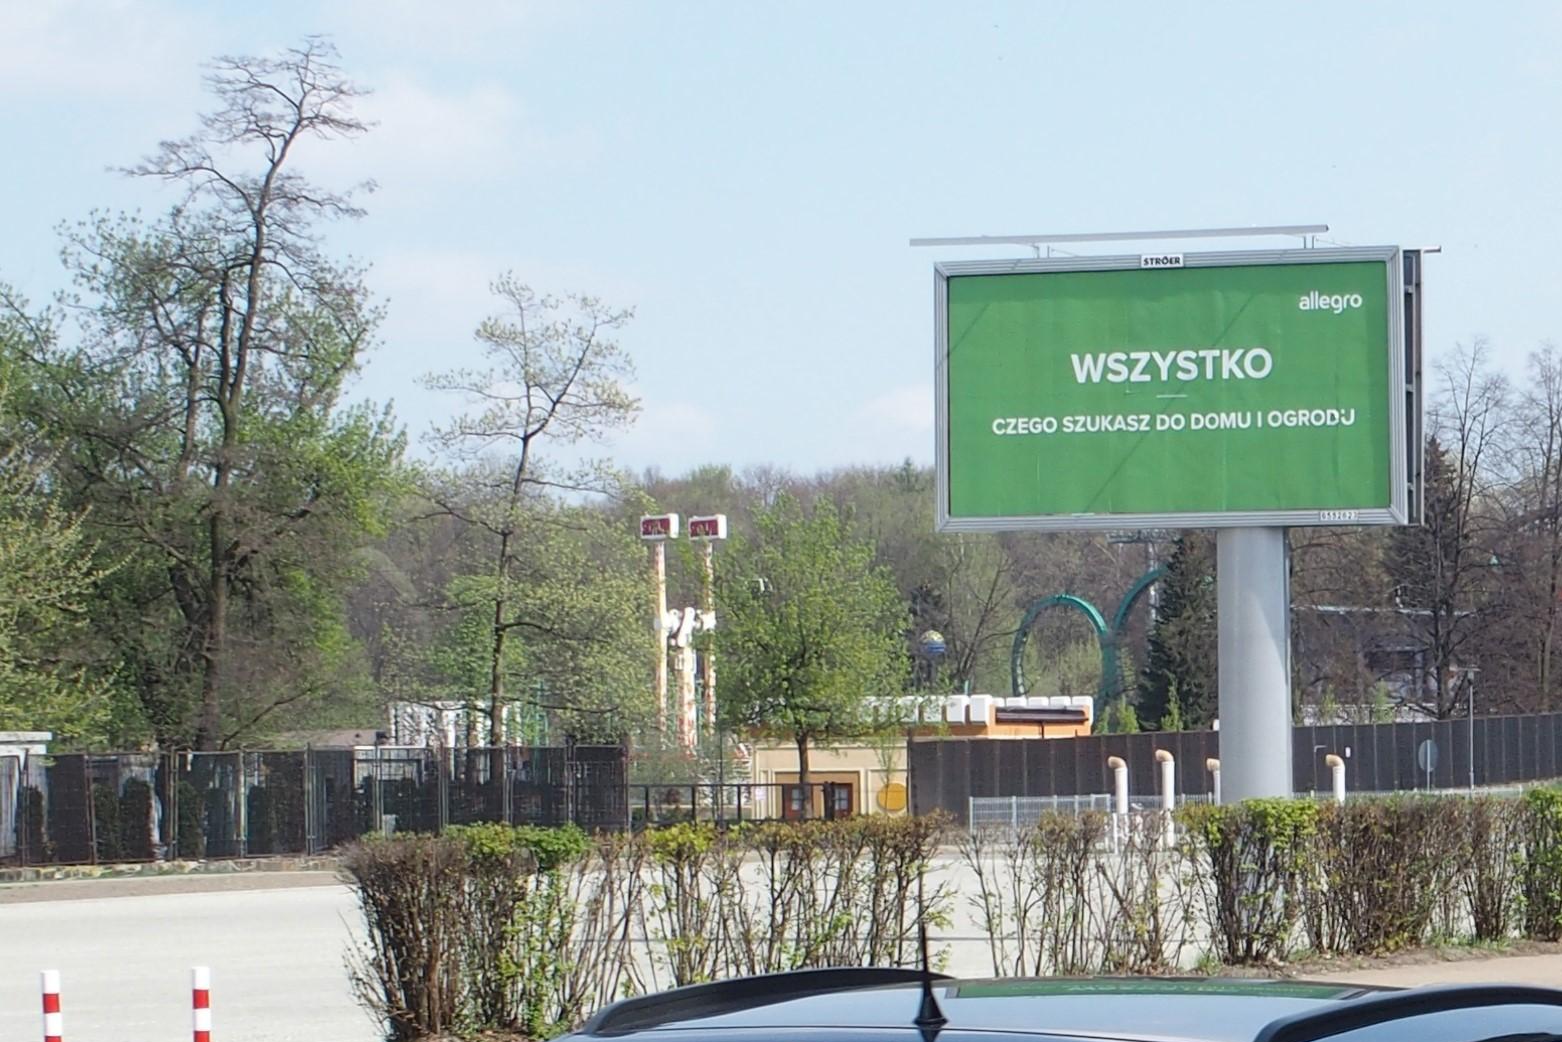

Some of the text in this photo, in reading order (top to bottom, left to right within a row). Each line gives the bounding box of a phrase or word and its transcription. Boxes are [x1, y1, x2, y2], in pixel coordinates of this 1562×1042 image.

[1299, 291, 1363, 314] allegro
[1071, 348, 1273, 383] WSZYSTKO
[992, 416, 1058, 435] CZEGO
[1062, 414, 1150, 433] SZUKASZ
[1155, 412, 1185, 431] DO
[1190, 410, 1251, 430] DOMU
[1256, 410, 1262, 428] I
